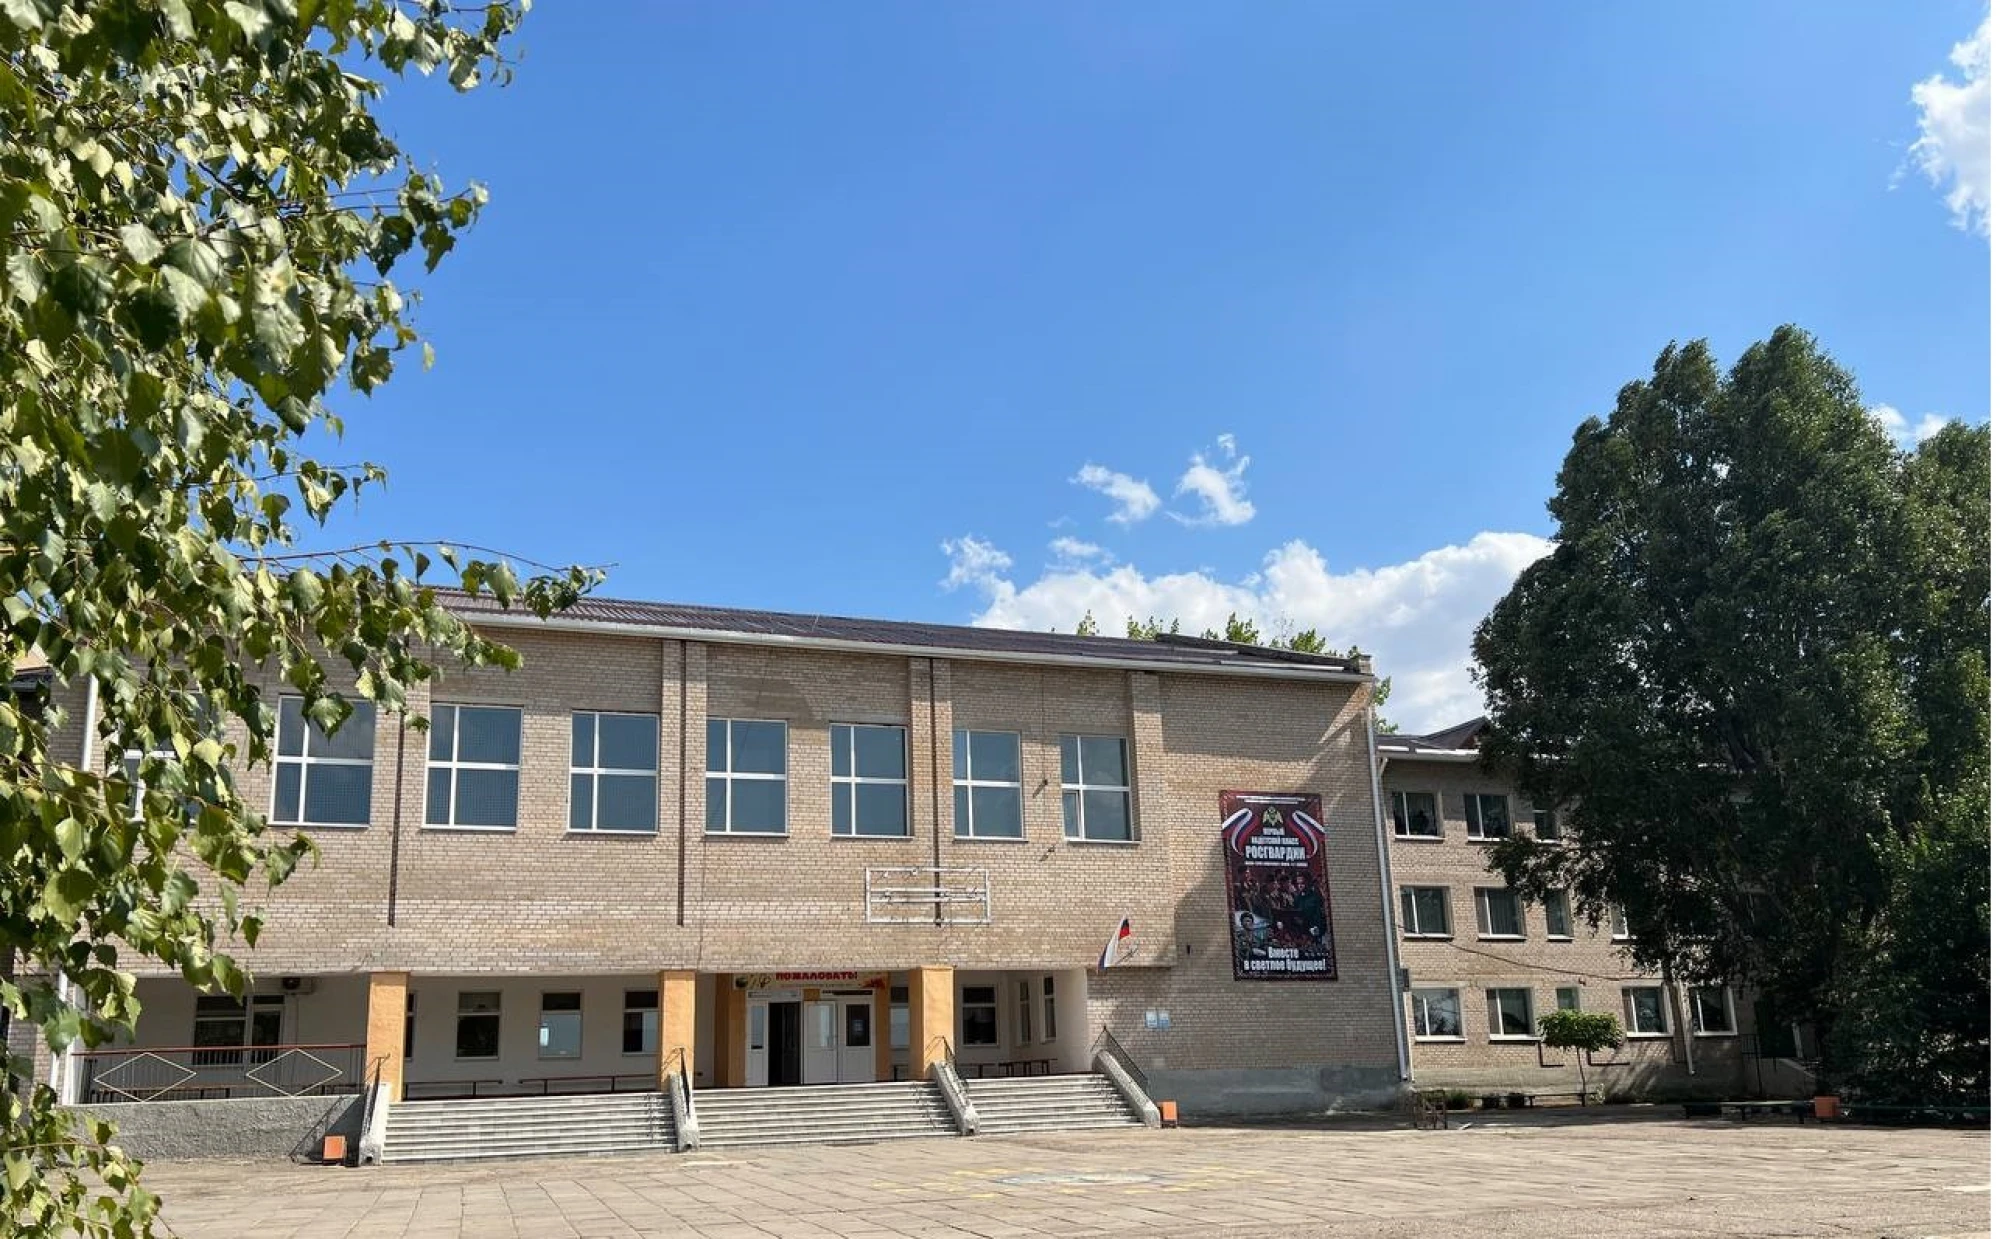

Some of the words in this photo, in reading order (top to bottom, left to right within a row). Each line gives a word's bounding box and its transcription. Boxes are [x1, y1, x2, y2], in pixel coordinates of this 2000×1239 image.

[1245, 845, 1306, 861] РОСГВАРДИИ
[1268, 946, 1299, 959] Вместе
[1251, 960, 1285, 971] светлое
[1286, 958, 1326, 972] будущее!
[775, 971, 858, 981] ПОЖАЛОВАТЬ!
